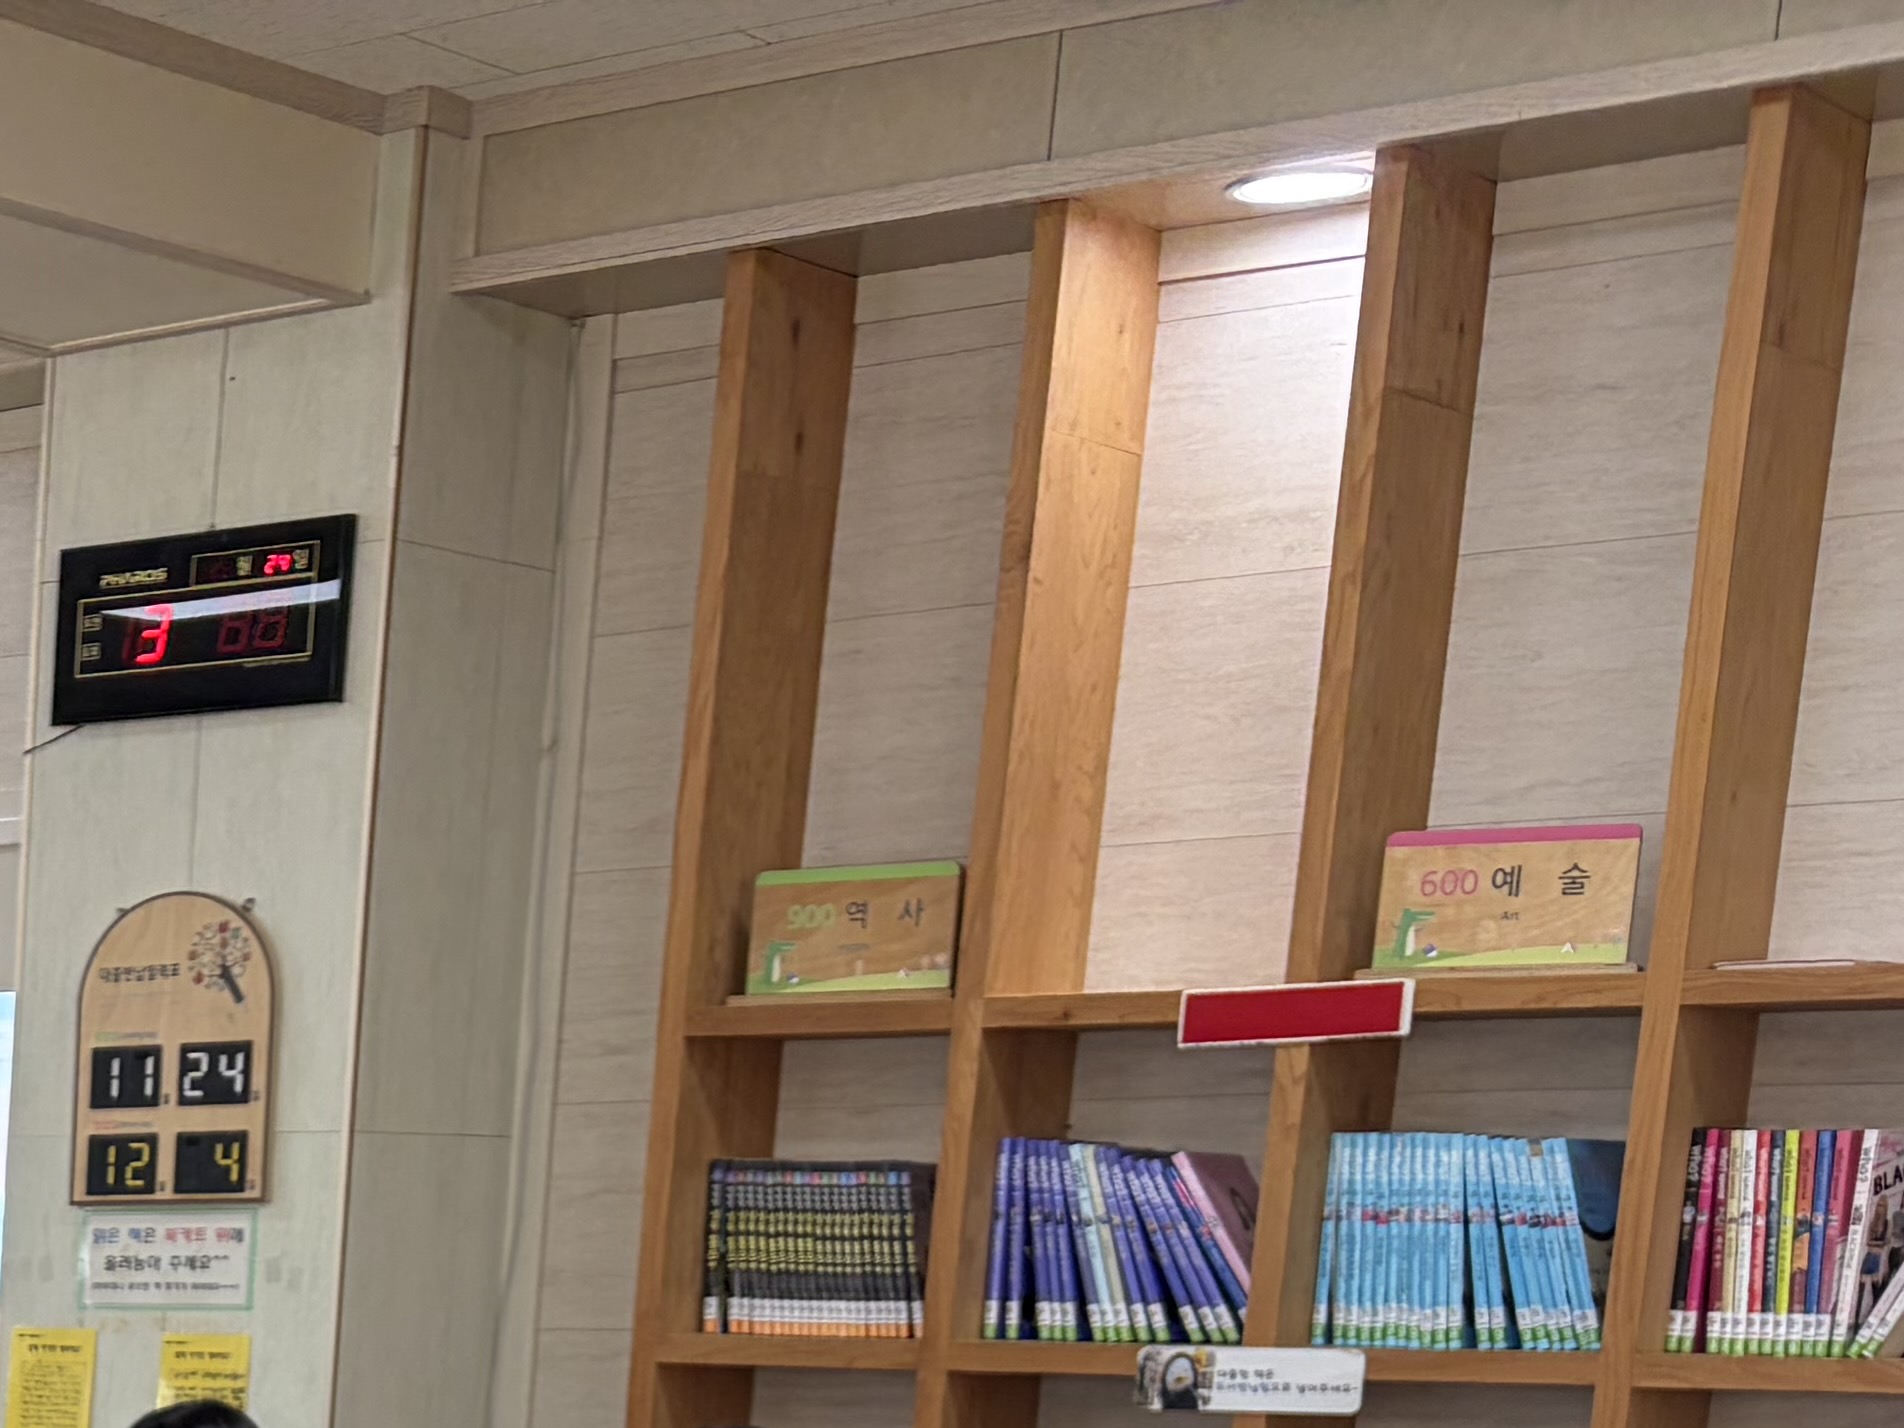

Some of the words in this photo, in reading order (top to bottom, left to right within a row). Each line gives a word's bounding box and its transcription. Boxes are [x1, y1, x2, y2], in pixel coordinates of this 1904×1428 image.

[1420, 869, 1478, 896] 600
[1492, 864, 1522, 897] 예
[1558, 862, 1591, 895] 술
[110, 1056, 154, 1098] 11
[183, 1052, 245, 1096] 24
[107, 1142, 150, 1186] 12
[214, 1142, 240, 1182] 4
[1873, 1165, 1904, 1196] BLA
